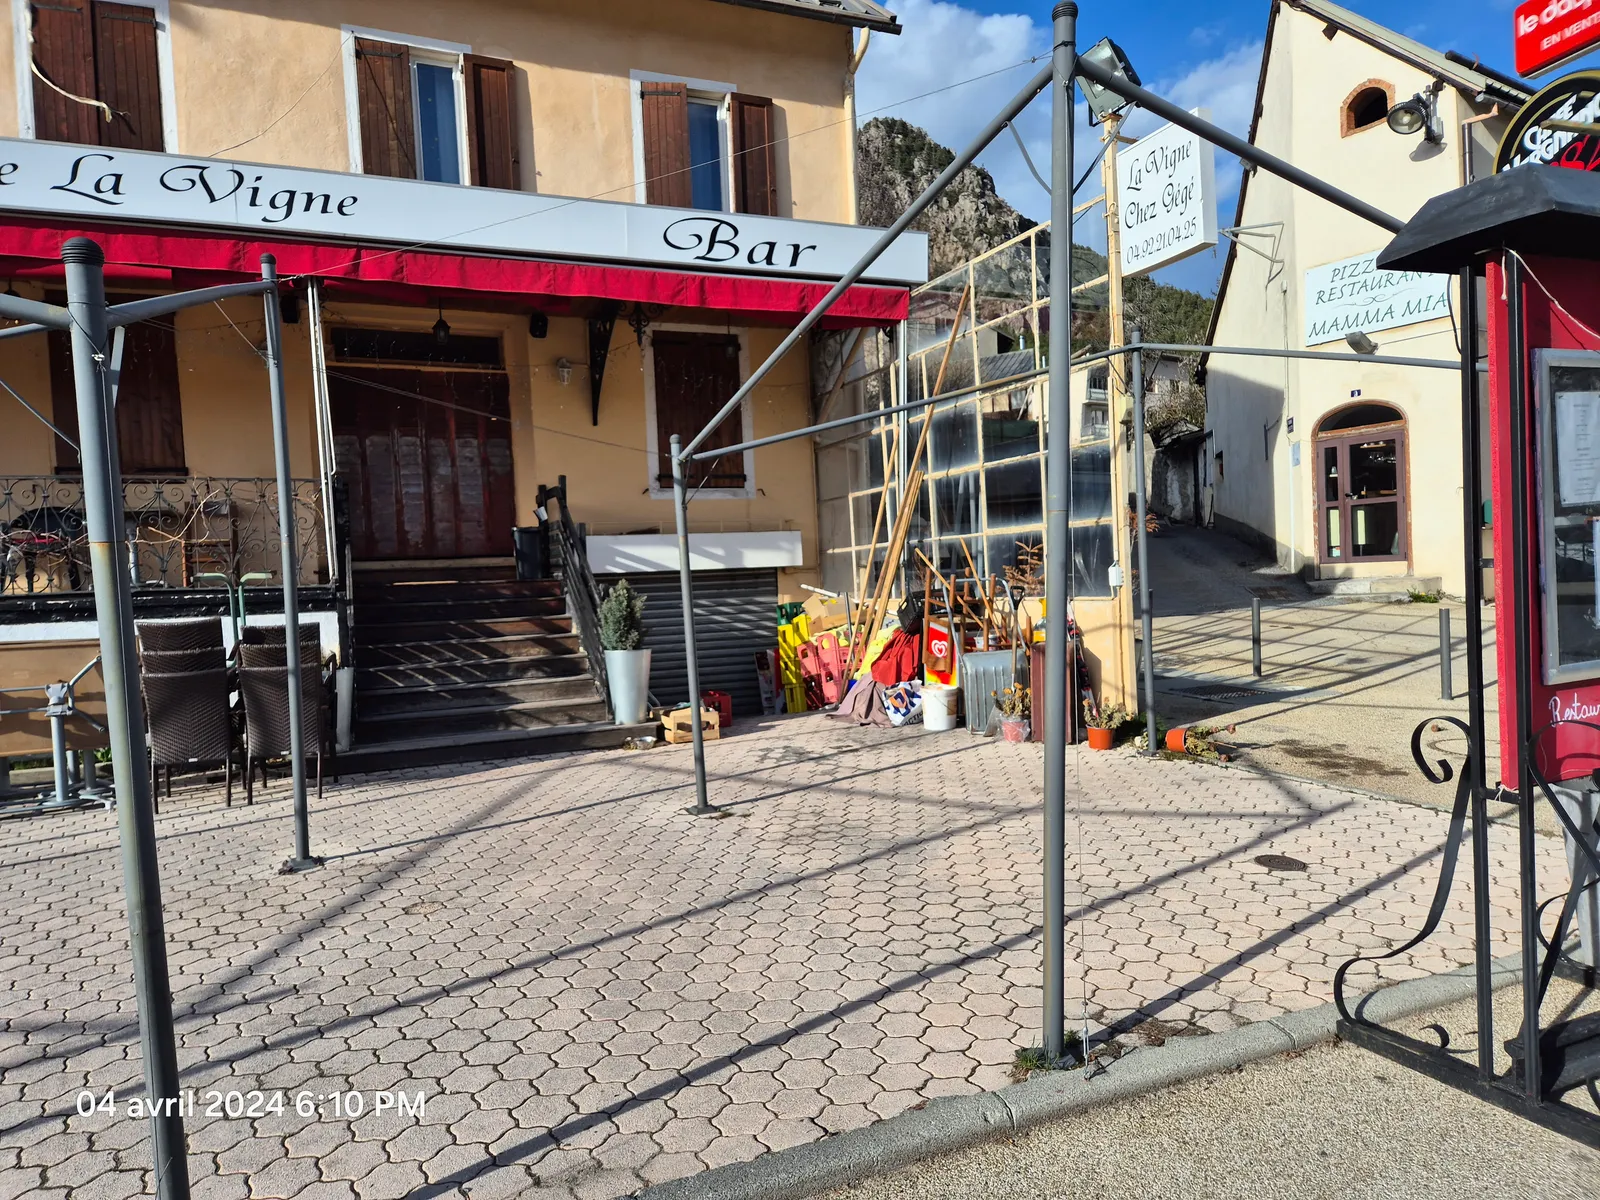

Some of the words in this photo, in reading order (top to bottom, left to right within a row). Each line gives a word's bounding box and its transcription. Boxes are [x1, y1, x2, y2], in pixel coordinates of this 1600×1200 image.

[1516, 14, 1539, 38] le
[1540, 30, 1562, 51] EN
[50, 153, 126, 205] La
[159, 165, 358, 223] Vigne
[1127, 158, 1142, 191] La
[1145, 140, 1192, 178] Vigne
[1125, 201, 1158, 229] Chez
[1162, 175, 1195, 216] Gégé
[663, 217, 817, 267] Bar
[1127, 216, 1197, 264] 04.92.21.04.25
[1315, 271, 1434, 305] RESTAURAN
[1330, 257, 1378, 284] PIZZ
[1308, 304, 1396, 338] MAMMA
[1401, 291, 1447, 318] MIA
